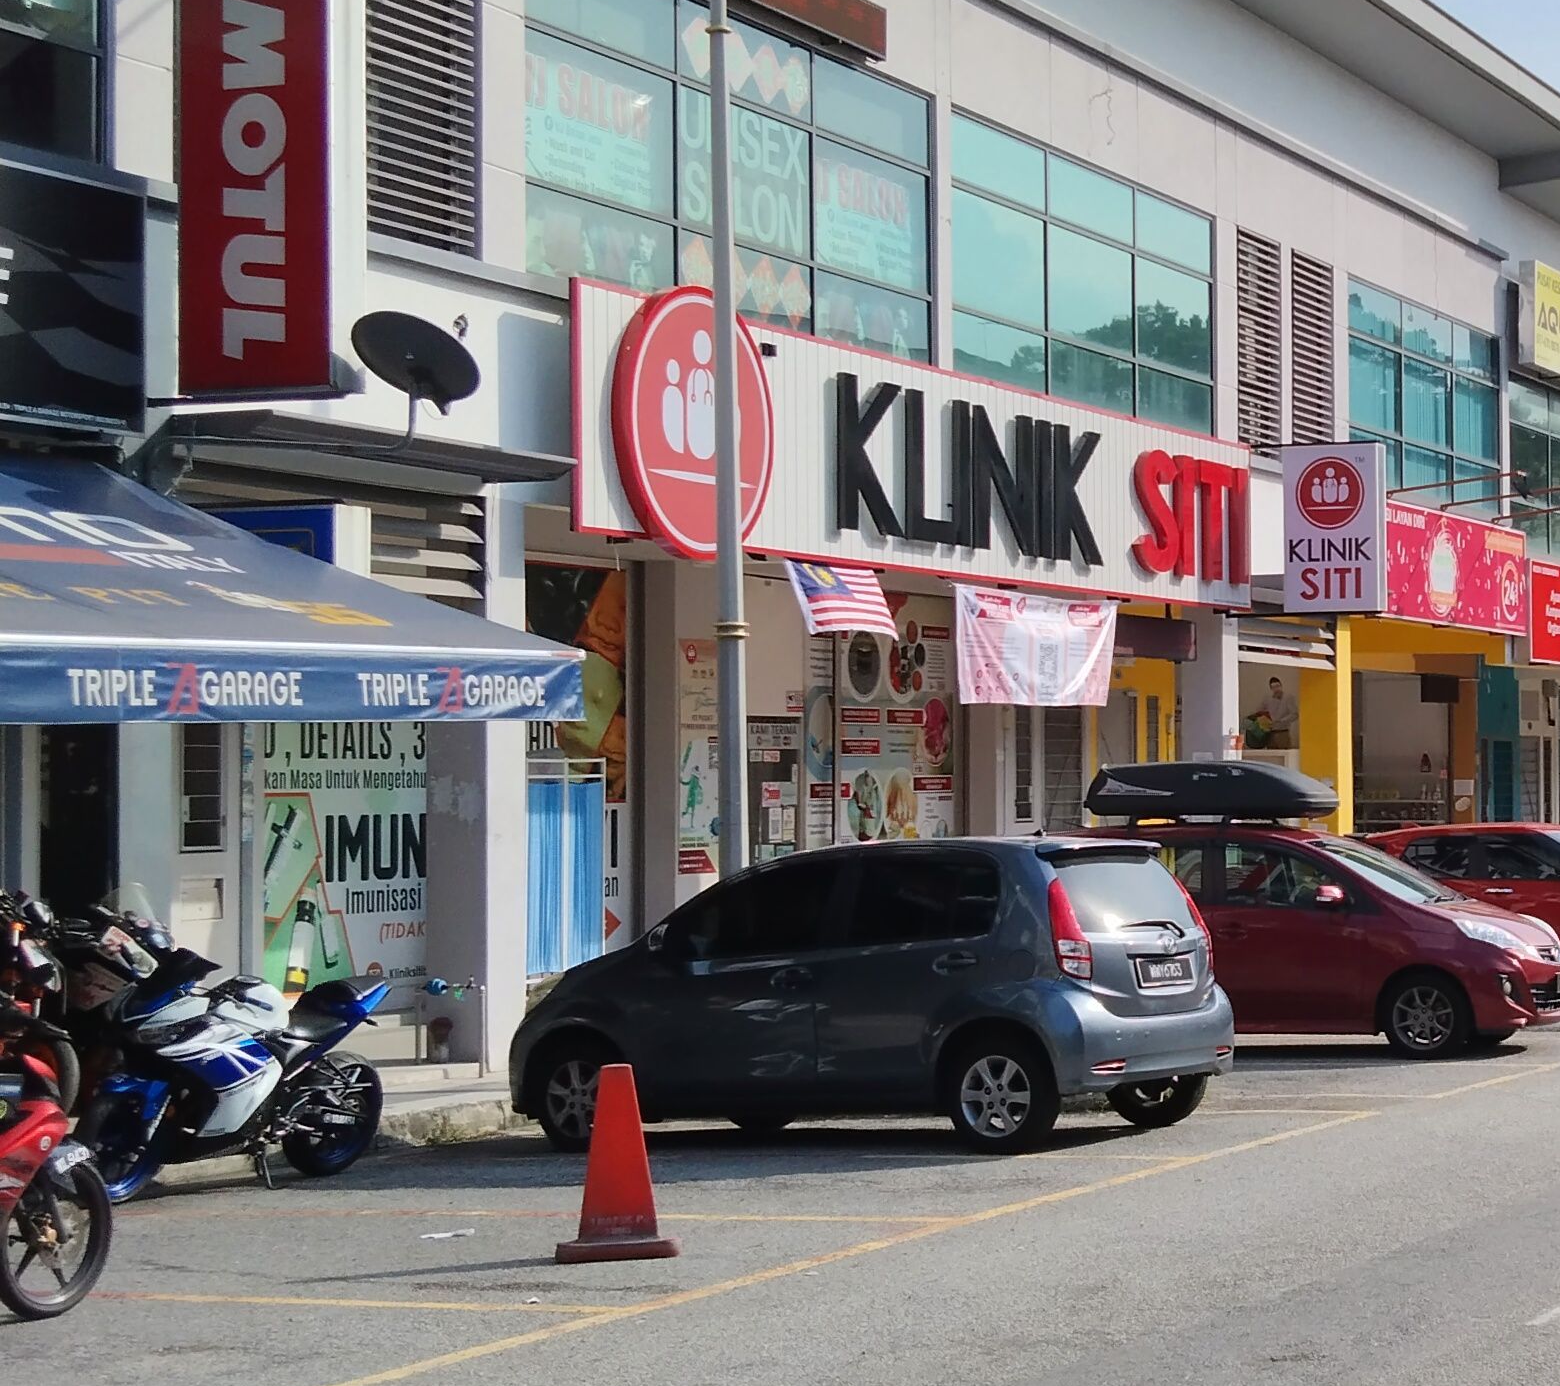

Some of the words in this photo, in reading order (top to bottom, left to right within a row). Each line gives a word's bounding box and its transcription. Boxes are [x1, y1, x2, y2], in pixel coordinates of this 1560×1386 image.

[557, 62, 651, 148] SALON
[681, 86, 806, 186] UISEX
[684, 161, 804, 257] SLON
[836, 371, 1104, 567] KLINIK
[1131, 449, 1250, 585] SITI
[1288, 536, 1372, 563] KLINIK
[1300, 567, 1362, 601] SITI
[67, 669, 157, 706] TRIPLE
[202, 671, 303, 706] GARAGE
[358, 672, 430, 707] TRIPLE
[464, 675, 546, 708] GARAGE
[301, 722, 392, 760] DETAILS
[290, 771, 322, 790] Masa
[326, 769, 360, 790] Untuk
[346, 883, 422, 915] Imunisasi
[379, 920, 427, 945] (TIDAK
